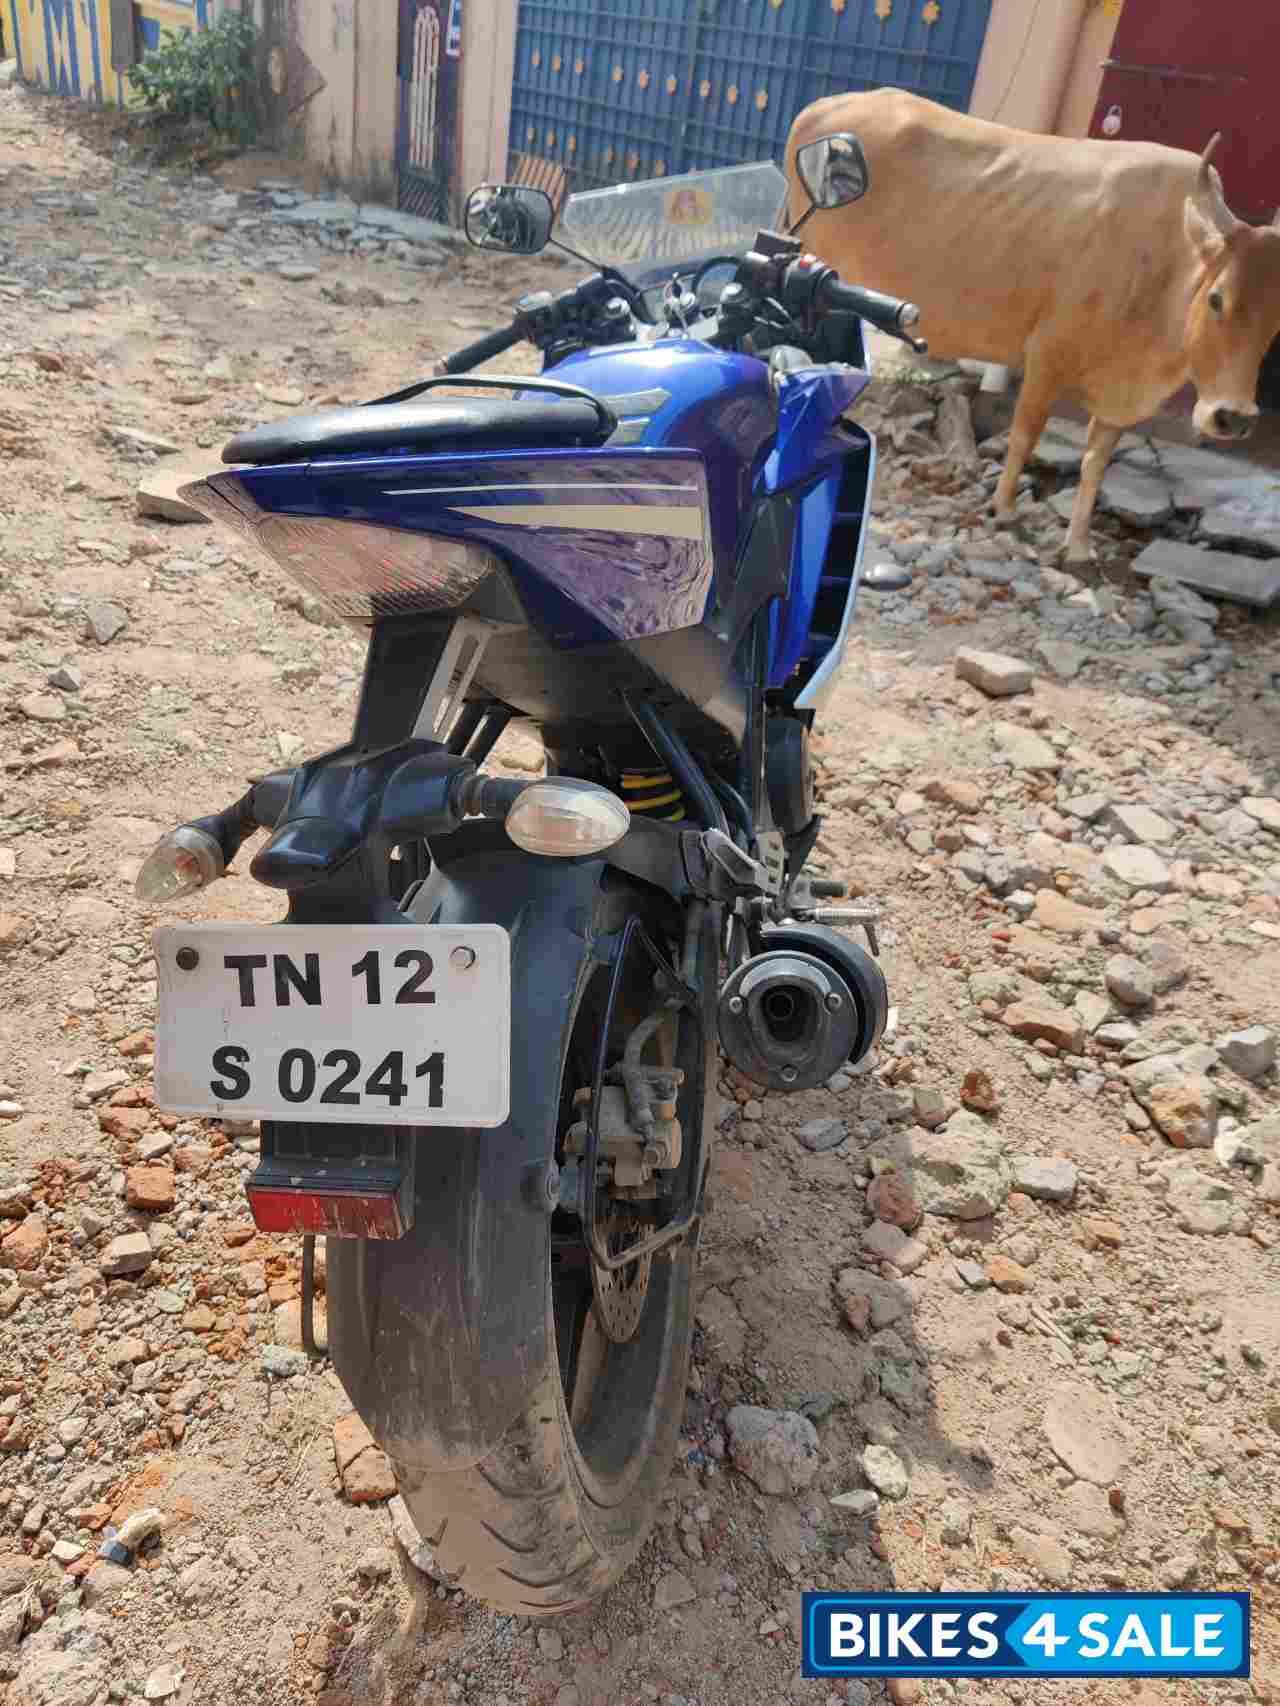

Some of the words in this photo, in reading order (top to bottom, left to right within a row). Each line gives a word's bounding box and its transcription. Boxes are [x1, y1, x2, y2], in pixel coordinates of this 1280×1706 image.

[223, 952, 322, 1007] TN
[351, 949, 436, 1005] 12
[209, 1045, 251, 1101] S
[278, 1047, 446, 1108] 0241
